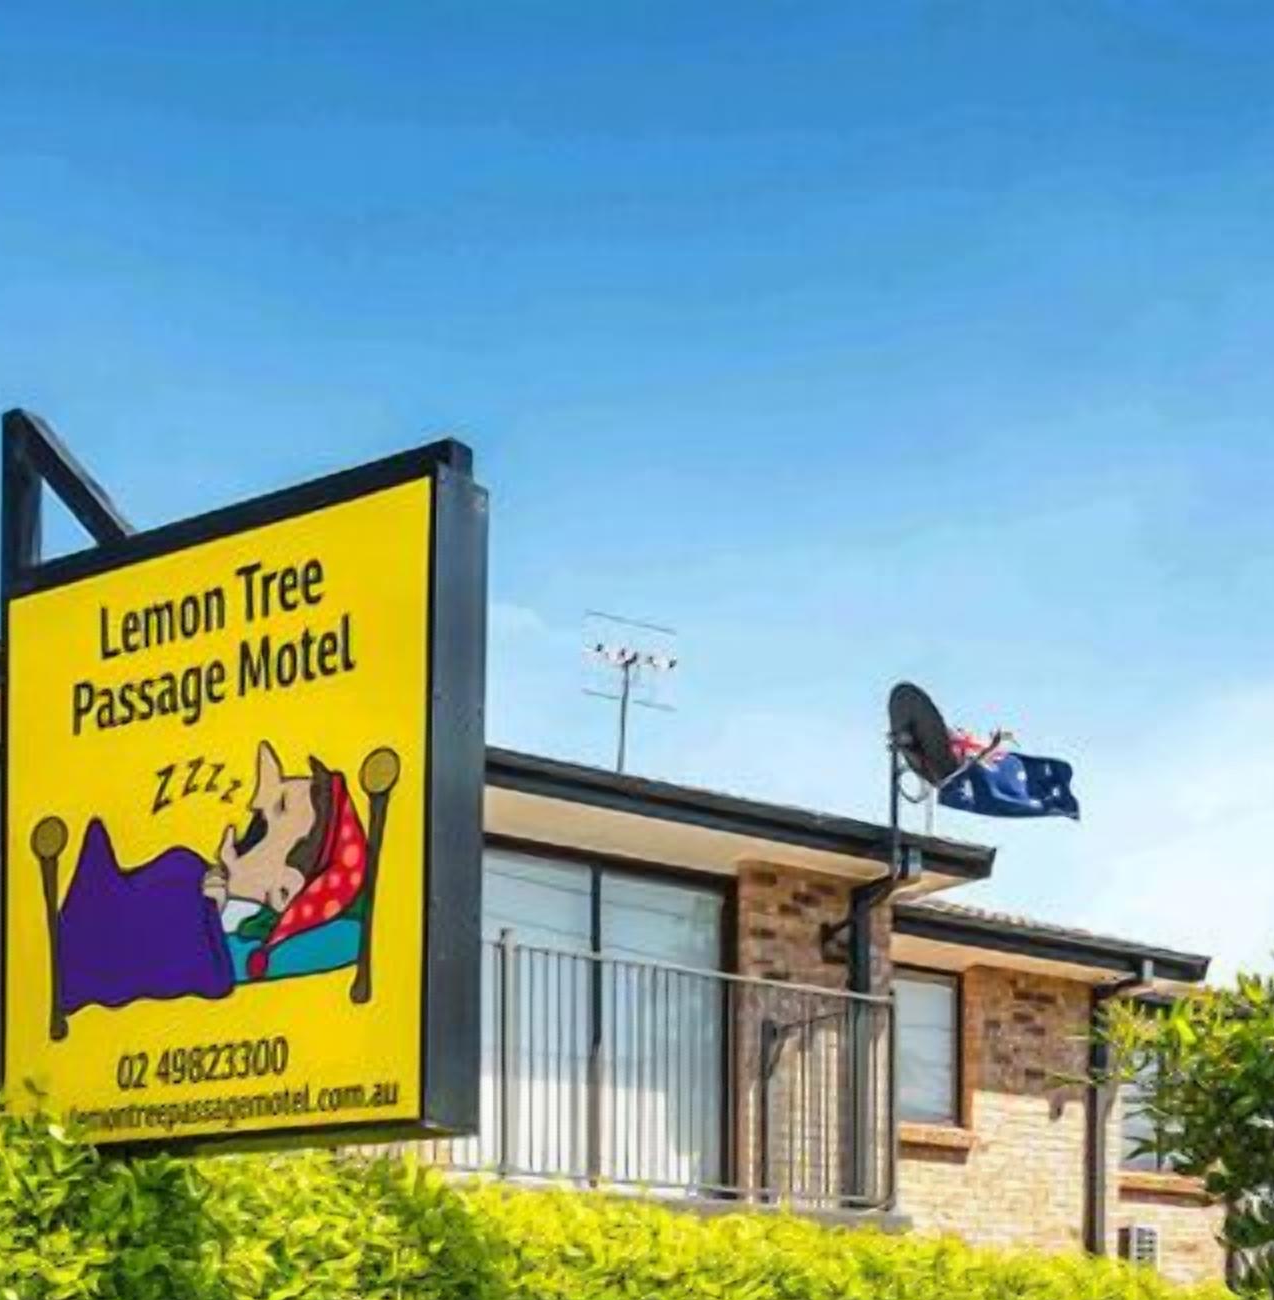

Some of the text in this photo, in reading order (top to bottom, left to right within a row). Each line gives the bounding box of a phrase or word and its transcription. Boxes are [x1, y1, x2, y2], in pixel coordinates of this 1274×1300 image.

[99, 558, 325, 661] Lemon Tree
[72, 612, 356, 736] Passage Motel
[116, 1035, 289, 1091] 02 49823300
